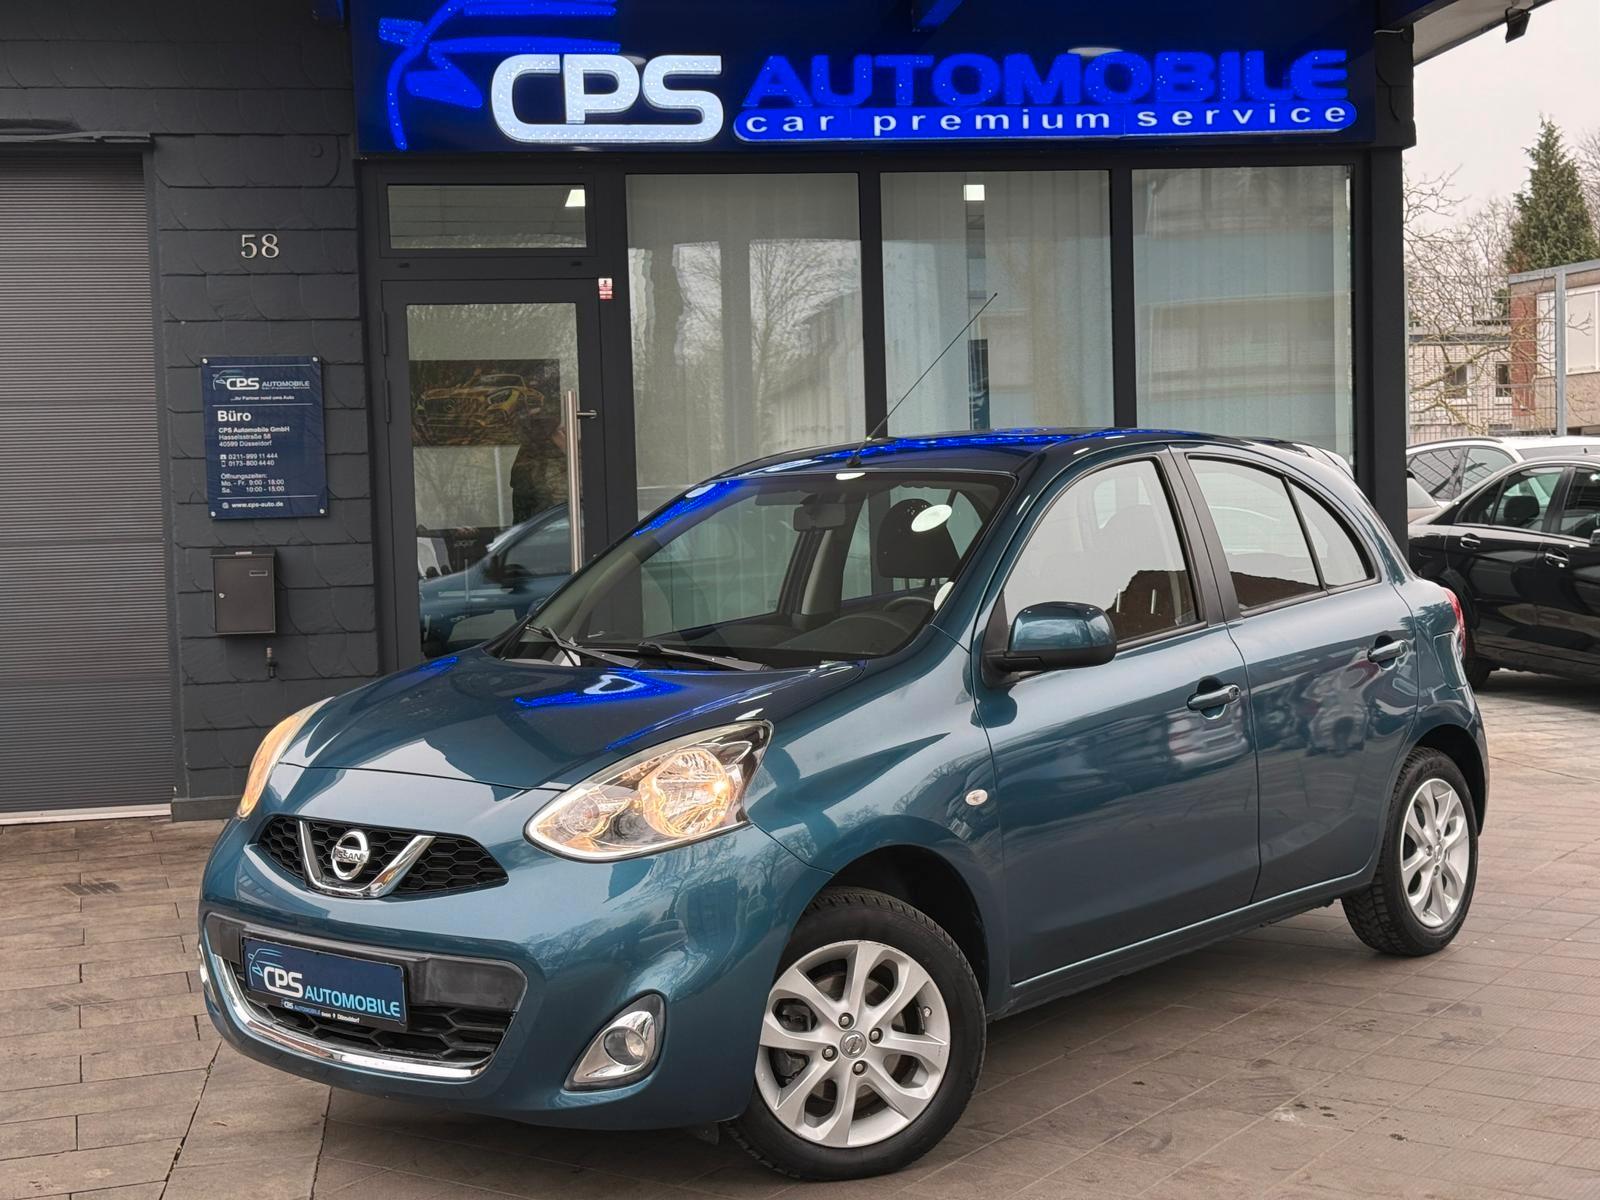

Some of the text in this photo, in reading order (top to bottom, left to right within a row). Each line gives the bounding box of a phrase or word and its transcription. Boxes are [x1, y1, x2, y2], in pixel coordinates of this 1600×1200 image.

[491, 50, 1348, 143] CPS AUTOMOBILE
[746, 103, 1347, 137] car premium service
[241, 233, 280, 259] 58
[226, 378, 260, 390] CPS
[218, 410, 252, 422] Büro
[264, 966, 400, 1017] CPS AUTOMOBILE
